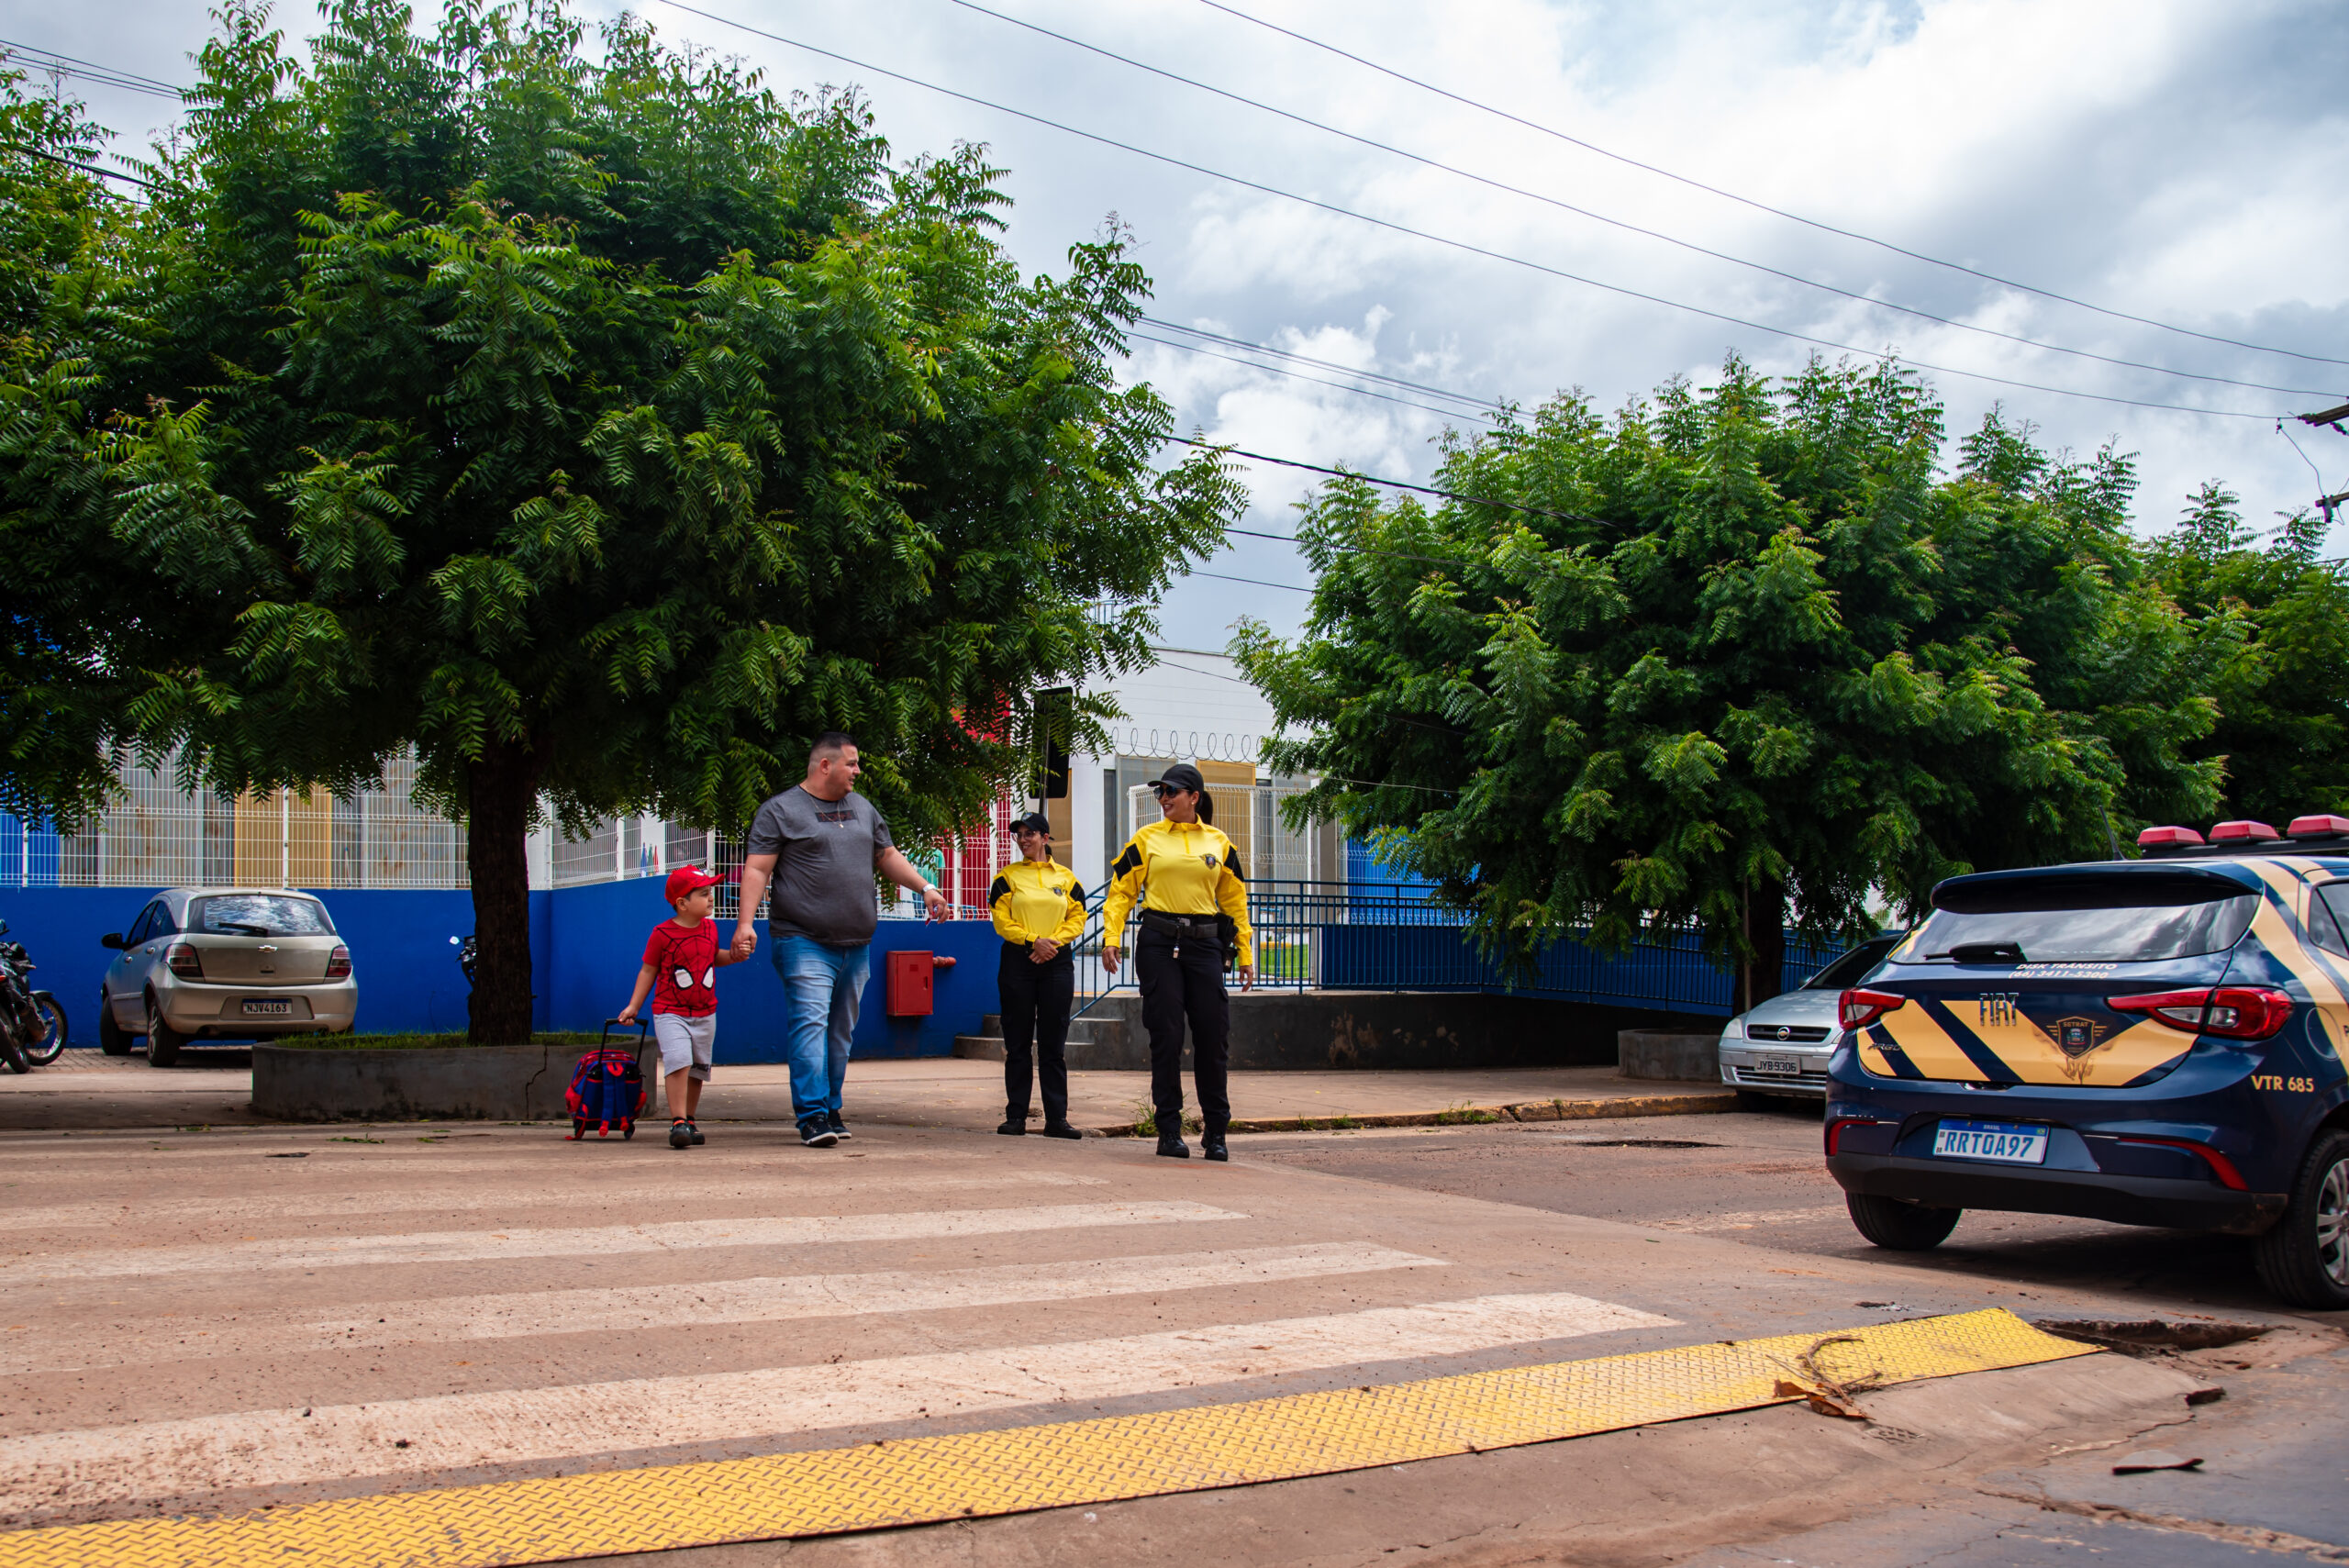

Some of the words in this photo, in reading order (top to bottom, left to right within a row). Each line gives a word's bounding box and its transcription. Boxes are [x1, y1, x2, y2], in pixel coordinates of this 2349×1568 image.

[2009, 971, 2034, 979] (66)
[2037, 971, 2110, 979] 3411-5300
[1979, 992, 2020, 1027] FIAT
[1867, 1042, 1901, 1051] ARGO
[2251, 1075, 2284, 1091] VTR
[2288, 1076, 2315, 1093] 685
